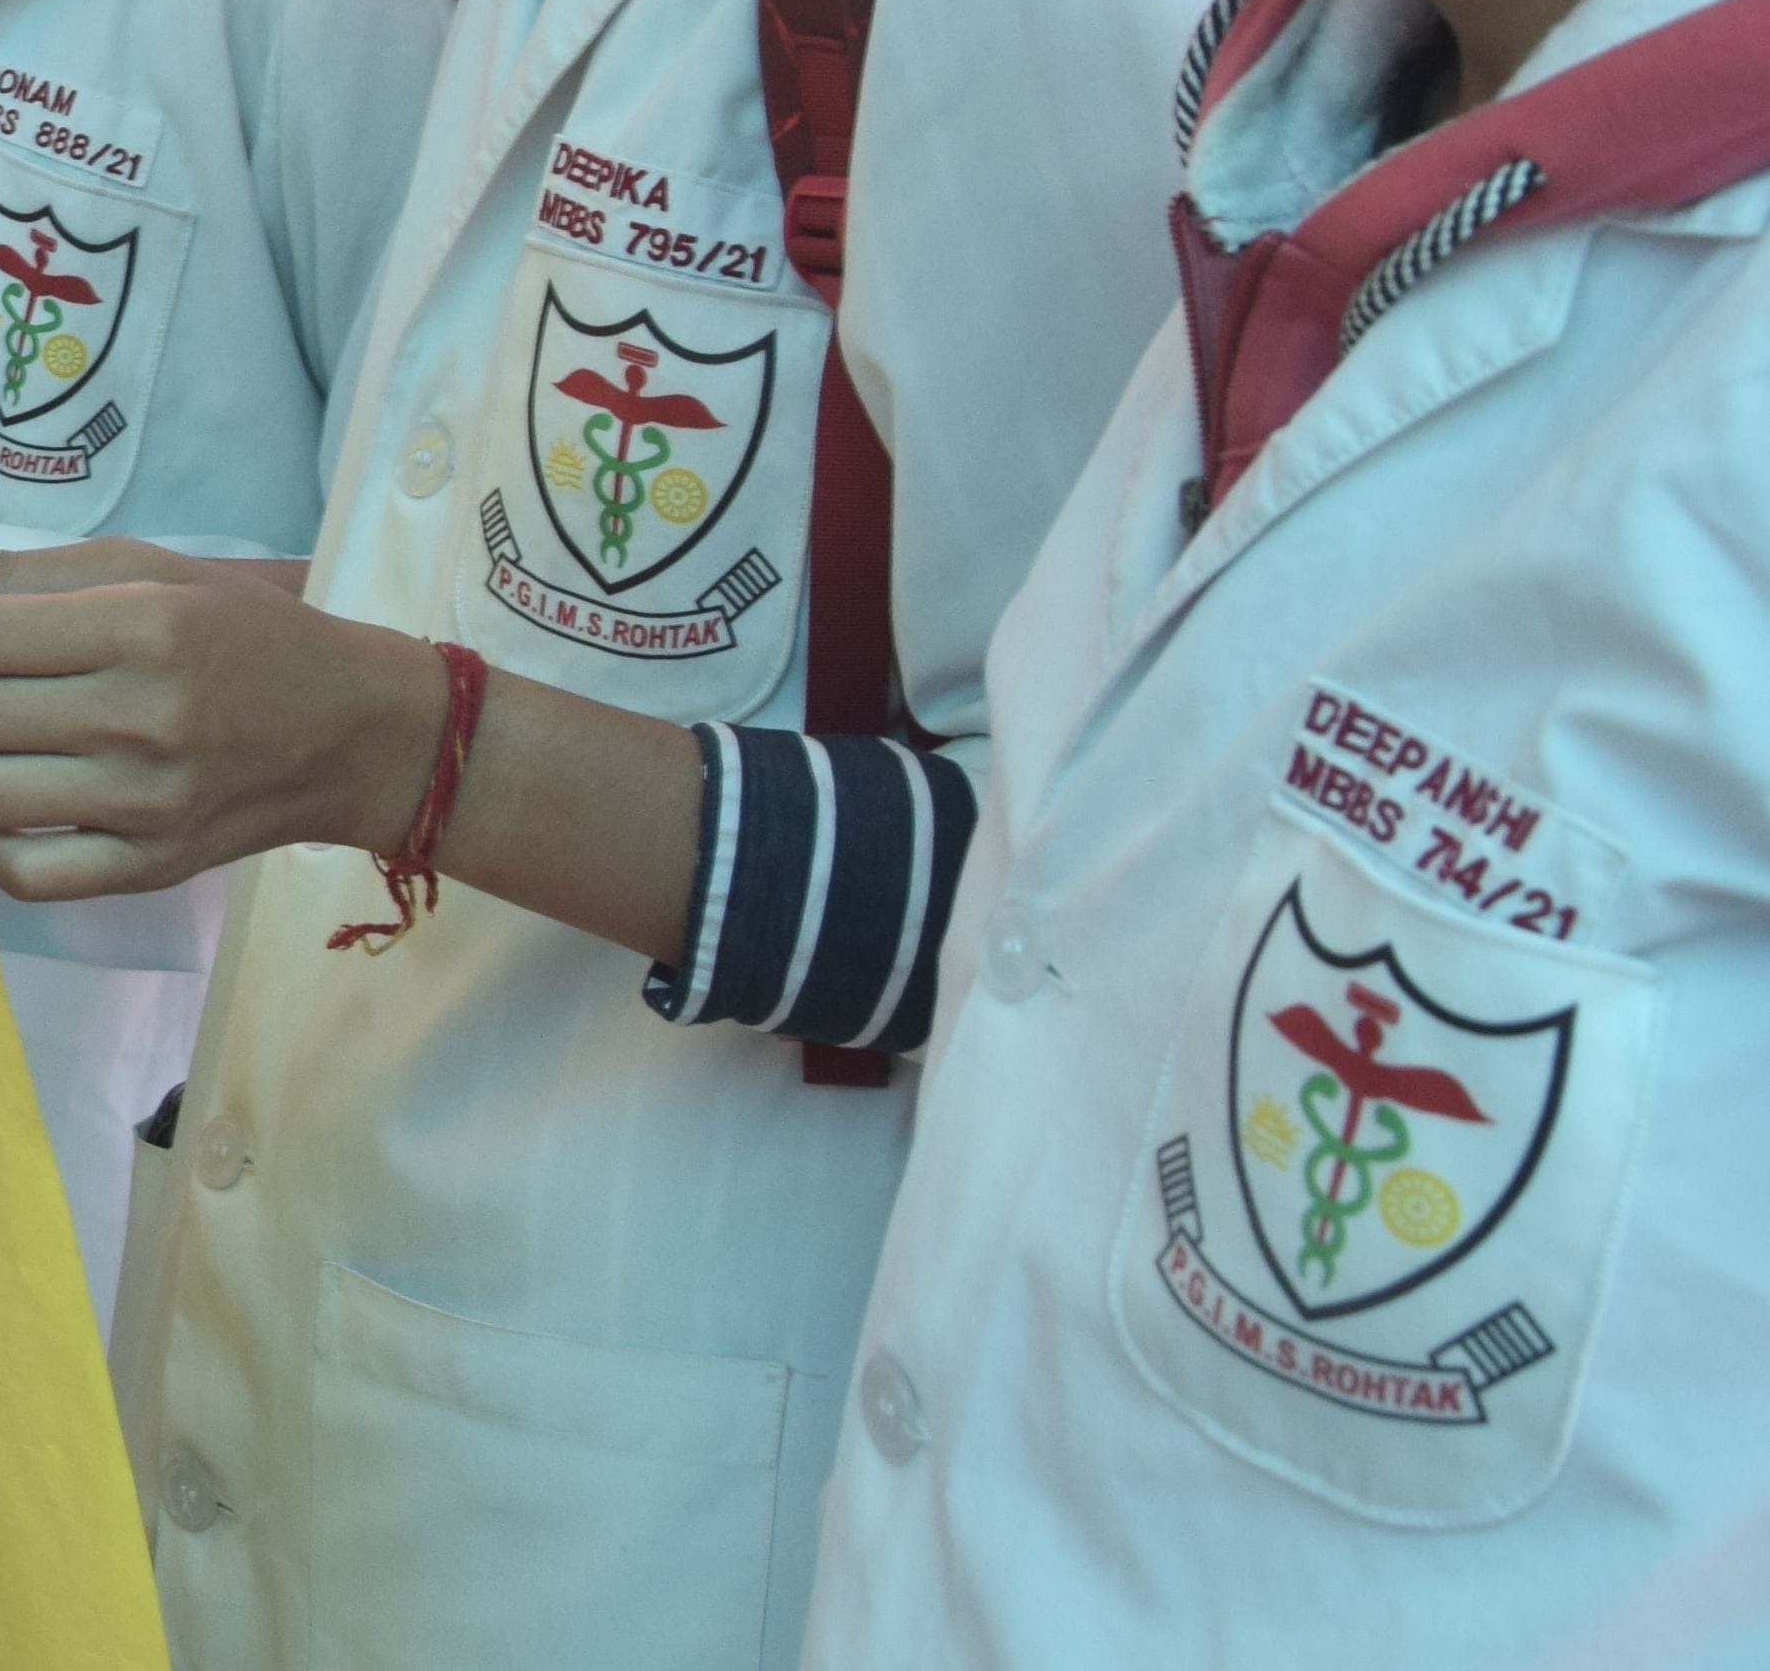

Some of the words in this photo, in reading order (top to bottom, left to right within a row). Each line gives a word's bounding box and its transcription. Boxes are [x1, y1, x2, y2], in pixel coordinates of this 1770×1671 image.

[33, 119, 143, 183] 888/21
[551, 142, 670, 213] DEEPIKA
[538, 188, 607, 246] MBBS
[625, 220, 768, 283] 795/21
[1285, 741, 1406, 844] MBBS
